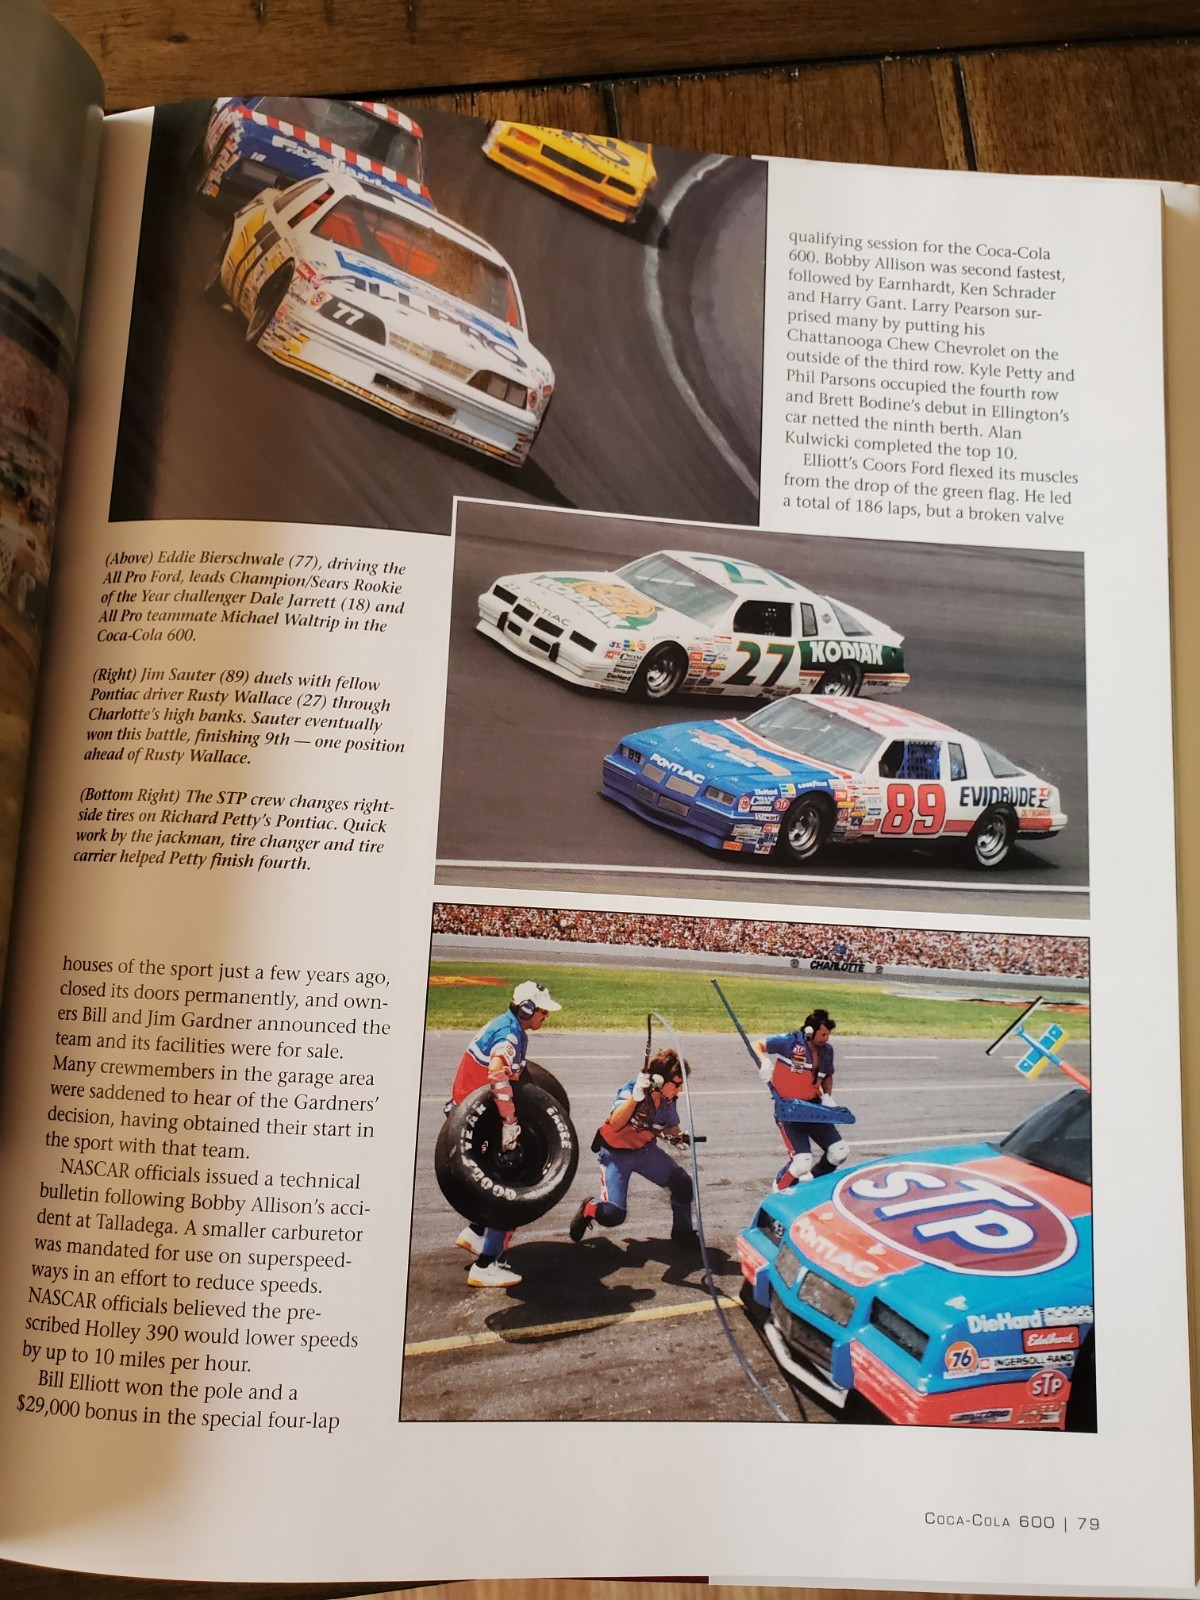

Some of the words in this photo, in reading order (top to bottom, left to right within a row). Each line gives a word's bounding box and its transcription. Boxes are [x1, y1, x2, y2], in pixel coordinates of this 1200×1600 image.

[789, 232, 862, 251] qualifying
[867, 239, 917, 251] session
[923, 241, 943, 253] for
[948, 242, 971, 255] the
[976, 244, 1050, 260] Coca-Cola
[789, 250, 819, 263] 600.
[825, 252, 870, 271] Bobby
[875, 257, 925, 272] Allison
[931, 263, 957, 274] was
[962, 265, 1011, 277] second
[1017, 266, 1065, 282] fastest,
[789, 268, 850, 286] followed
[856, 275, 873, 291] by
[879, 277, 954, 295] Earnhardt,
[961, 282, 987, 296] Ken
[993, 285, 1056, 300] Schrader
[332, 302, 364, 326] 77
[788, 290, 815, 302] and
[821, 291, 861, 310] Harry
[866, 296, 906, 310] Gant.
[913, 299, 949, 317] Larry
[955, 302, 1009, 317] Pearson
[1015, 309, 1042, 319] sur-
[323, 276, 427, 313] ALL
[428, 305, 528, 369] PRO
[788, 310, 831, 324] prised
[836, 316, 878, 331] many
[883, 316, 900, 333] by
[906, 321, 959, 337] putting
[964, 322, 985, 336] his
[787, 329, 882, 351] Chattanooga
[887, 337, 929, 351] Chew
[934, 341, 1005, 357] Chevrolet
[1011, 349, 1029, 359] on
[1035, 347, 1058, 360] the
[785, 413, 807, 424] car
[812, 415, 859, 428] netted
[865, 416, 888, 430] the
[894, 420, 934, 433] ninth
[940, 421, 983, 437] berth.
[988, 425, 1021, 439] Alan
[786, 431, 848, 448] Kulwicki
[854, 439, 932, 455] completed
[938, 442, 961, 456] the
[966, 446, 991, 462] top
[998, 447, 1017, 460] 10.
[105, 551, 153, 568] (Above)
[157, 550, 196, 563] Eddie
[199, 551, 284, 566] Bierschwale
[289, 555, 322, 571] (77),
[327, 557, 379, 576] driving
[383, 562, 406, 575] the
[98, 609, 118, 623] All
[120, 609, 143, 622] Pro
[147, 610, 217, 622] teammate
[220, 610, 280, 625] Michael
[285, 613, 340, 632] Waltrip
[344, 617, 359, 630] in
[364, 619, 387, 632] the
[523, 596, 572, 628] PONTIAC
[97, 628, 163, 642] Coca-Cola
[167, 628, 196, 641] 600.
[727, 641, 795, 687] 27
[810, 641, 883, 665] KODIAK
[92, 667, 137, 684] (Right)
[140, 667, 165, 683] Jim
[168, 668, 216, 682] Sauter
[219, 670, 249, 686] (89)
[254, 671, 293, 685] duels
[298, 674, 331, 688] with
[335, 676, 380, 692] fellow
[90, 687, 140, 701] Pontiac
[143, 687, 184, 701] driver
[187, 688, 229, 706] Rusty
[235, 690, 292, 706] Wallace
[297, 694, 327, 710] (27)
[332, 696, 390, 715] through
[628, 749, 641, 763] 89
[650, 753, 706, 785] PONTIAC
[80, 787, 133, 804] (Bottom
[136, 788, 180, 806] Right)
[186, 789, 213, 804] The
[216, 791, 248, 805] STP
[250, 796, 286, 807] crew
[289, 794, 349, 813] changes
[353, 798, 394, 815] right-
[775, 799, 790, 811] STP
[881, 783, 947, 835] 89
[755, 813, 780, 822] Stewart
[810, 960, 866, 973] CHARLOTTE
[60, 980, 106, 997] closed
[110, 983, 129, 999] its
[134, 984, 179, 1001] doors
[184, 990, 298, 1011] permanently,
[305, 992, 338, 1008] and
[344, 997, 388, 1009] own-
[52, 1054, 97, 1077] Many
[100, 1062, 215, 1080] crewmembers
[220, 1065, 237, 1081] in
[244, 1066, 272, 1082] the
[277, 1071, 334, 1089] garage
[339, 1074, 374, 1086] area
[546, 1106, 572, 1150] EAGLE
[45, 1130, 69, 1148] the
[74, 1137, 114, 1154] sport
[119, 1137, 155, 1154] with
[162, 1139, 197, 1157] that
[202, 1143, 249, 1159] team.
[37, 1208, 72, 1227] dent
[76, 1214, 91, 1228] at
[96, 1213, 178, 1238] Talladega.
[183, 1219, 197, 1236] A
[202, 1221, 266, 1238] smaller
[271, 1224, 363, 1242] carburetor
[849, 1170, 1037, 1253] STP
[34, 1238, 62, 1252] was
[66, 1240, 149, 1259] mandated
[154, 1243, 180, 1261] for
[185, 1250, 213, 1263] use
[219, 1252, 241, 1264] on
[248, 1252, 352, 1272] superspeed-
[793, 1216, 880, 1279] PONTIAC
[28, 1286, 97, 1309] NASCAR
[101, 1294, 168, 1314] officials
[173, 1298, 246, 1318] believed
[252, 1302, 281, 1319] the
[286, 1308, 321, 1325] pre-
[966, 1310, 1043, 1334] DieHard
[951, 1350, 971, 1368] 76
[1031, 1373, 1063, 1397] STP
[1019, 1515, 1055, 1530] 600
[1077, 1518, 1100, 1532] 79
